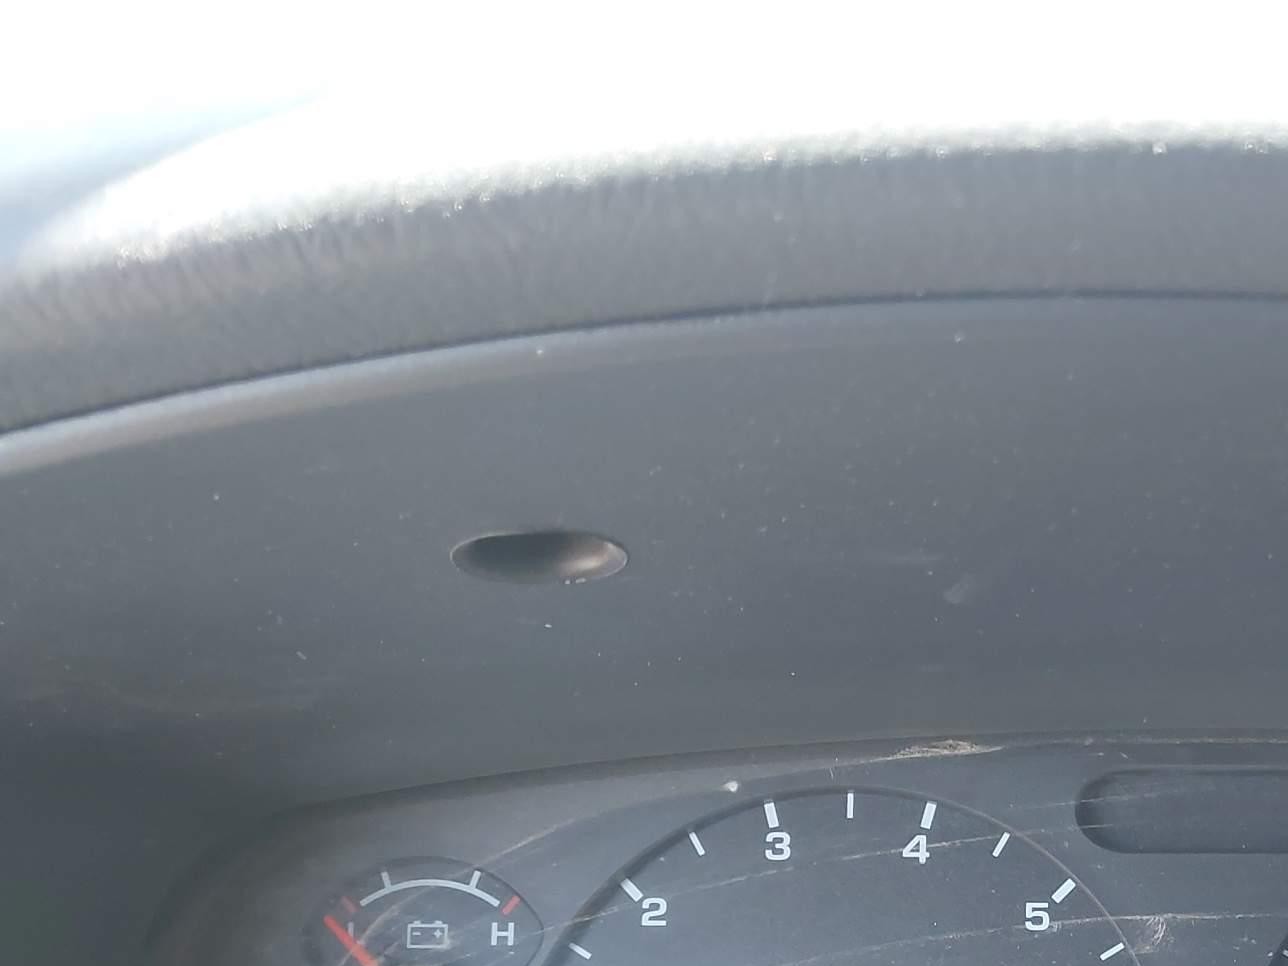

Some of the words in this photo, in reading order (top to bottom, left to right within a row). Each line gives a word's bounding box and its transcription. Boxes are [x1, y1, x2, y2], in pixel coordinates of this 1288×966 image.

[764, 832, 791, 860] 3
[902, 835, 930, 864] 4
[641, 898, 667, 926] 2
[1024, 902, 1050, 931] 5
[491, 922, 515, 946] H
